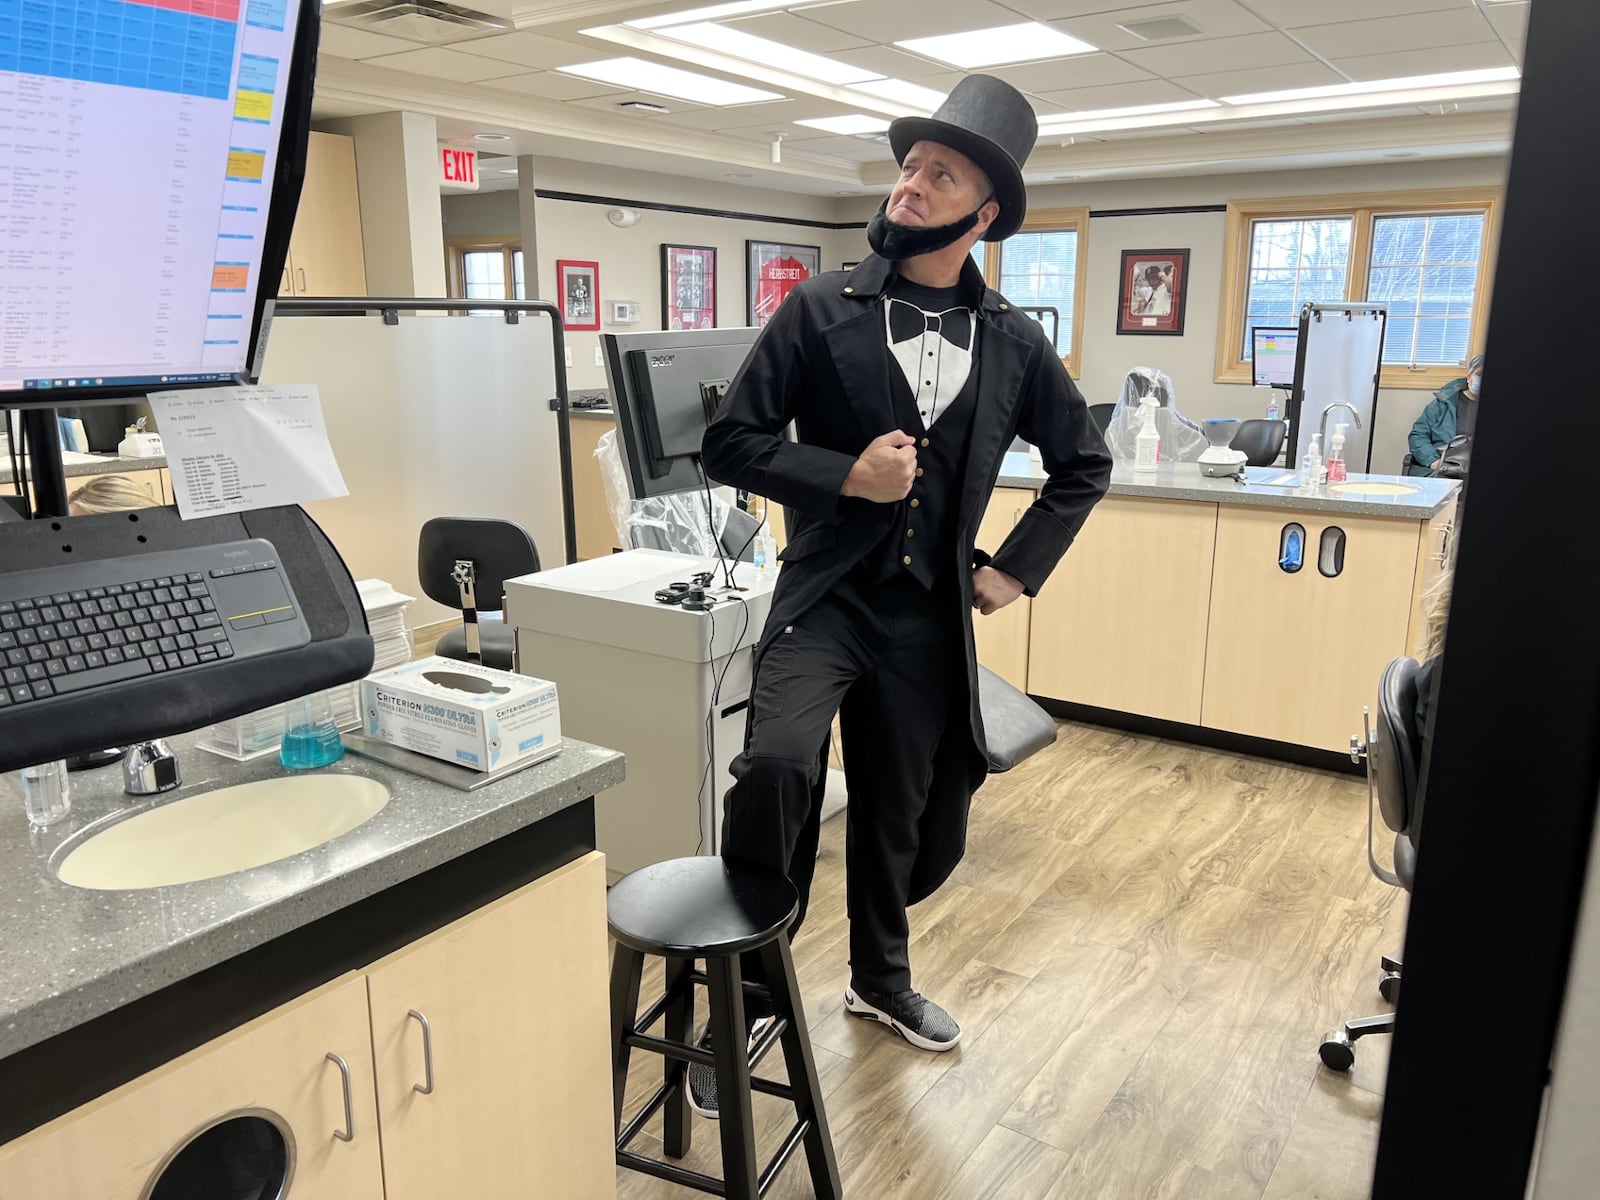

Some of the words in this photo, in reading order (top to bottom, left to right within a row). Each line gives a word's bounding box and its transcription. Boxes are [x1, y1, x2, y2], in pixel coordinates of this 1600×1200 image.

[443, 149, 474, 183] EXIT
[376, 692, 422, 711] CRITERION
[446, 708, 476, 726] ULTRA
[496, 704, 526, 718] CRITERION
